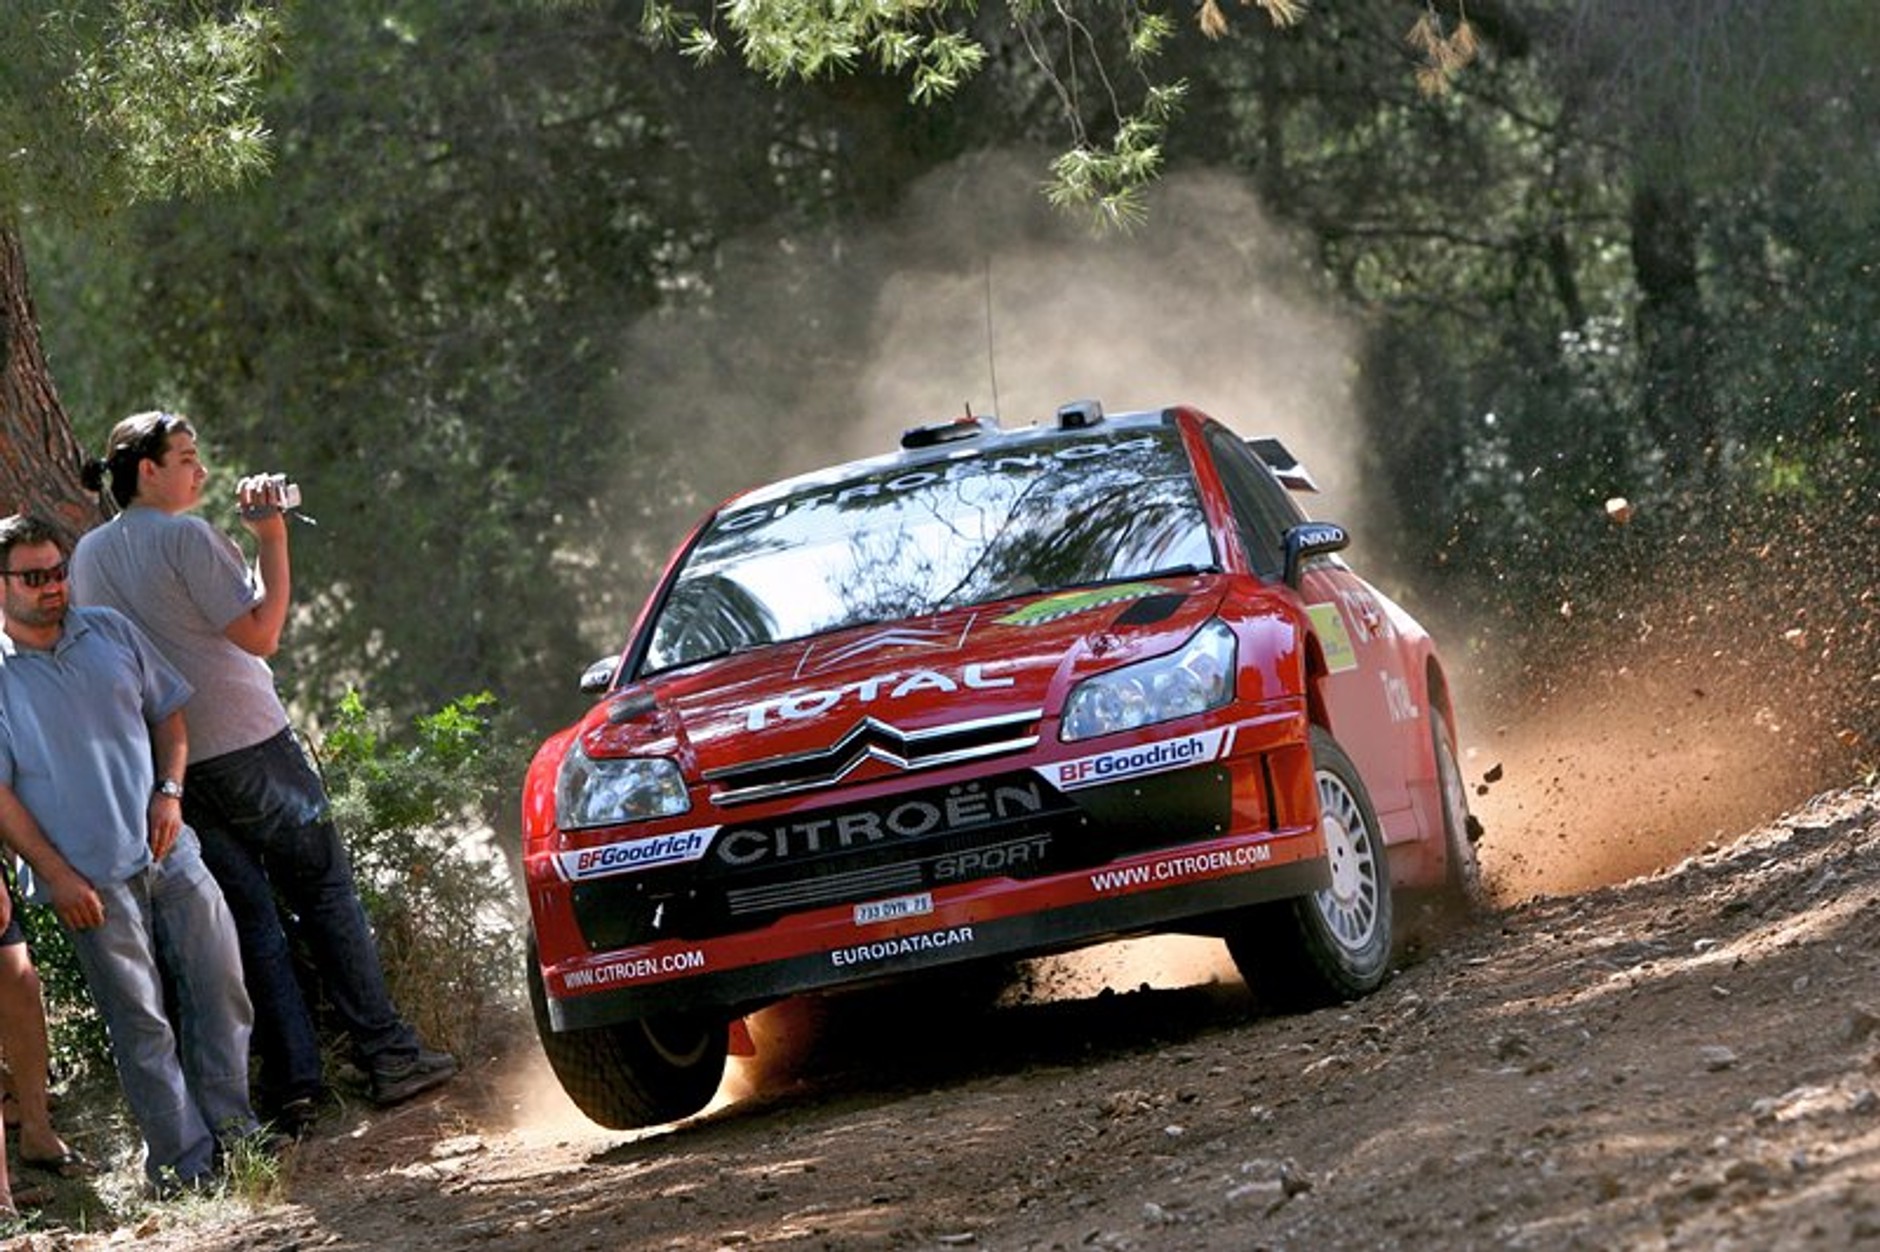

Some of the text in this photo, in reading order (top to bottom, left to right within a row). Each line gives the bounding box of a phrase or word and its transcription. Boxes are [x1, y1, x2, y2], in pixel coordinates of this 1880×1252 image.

[730, 664, 1014, 731] TOTAL
[1059, 738, 1203, 783] BFGoodrich
[716, 781, 1042, 866] CITROËN
[578, 833, 702, 870] BFGoodrich
[933, 838, 1052, 880] SPORT
[1091, 844, 1271, 892] WWW.CITROEN.COM
[831, 927, 974, 967] EURODATACAR
[564, 950, 704, 989] WWW.CITROEN.COM
